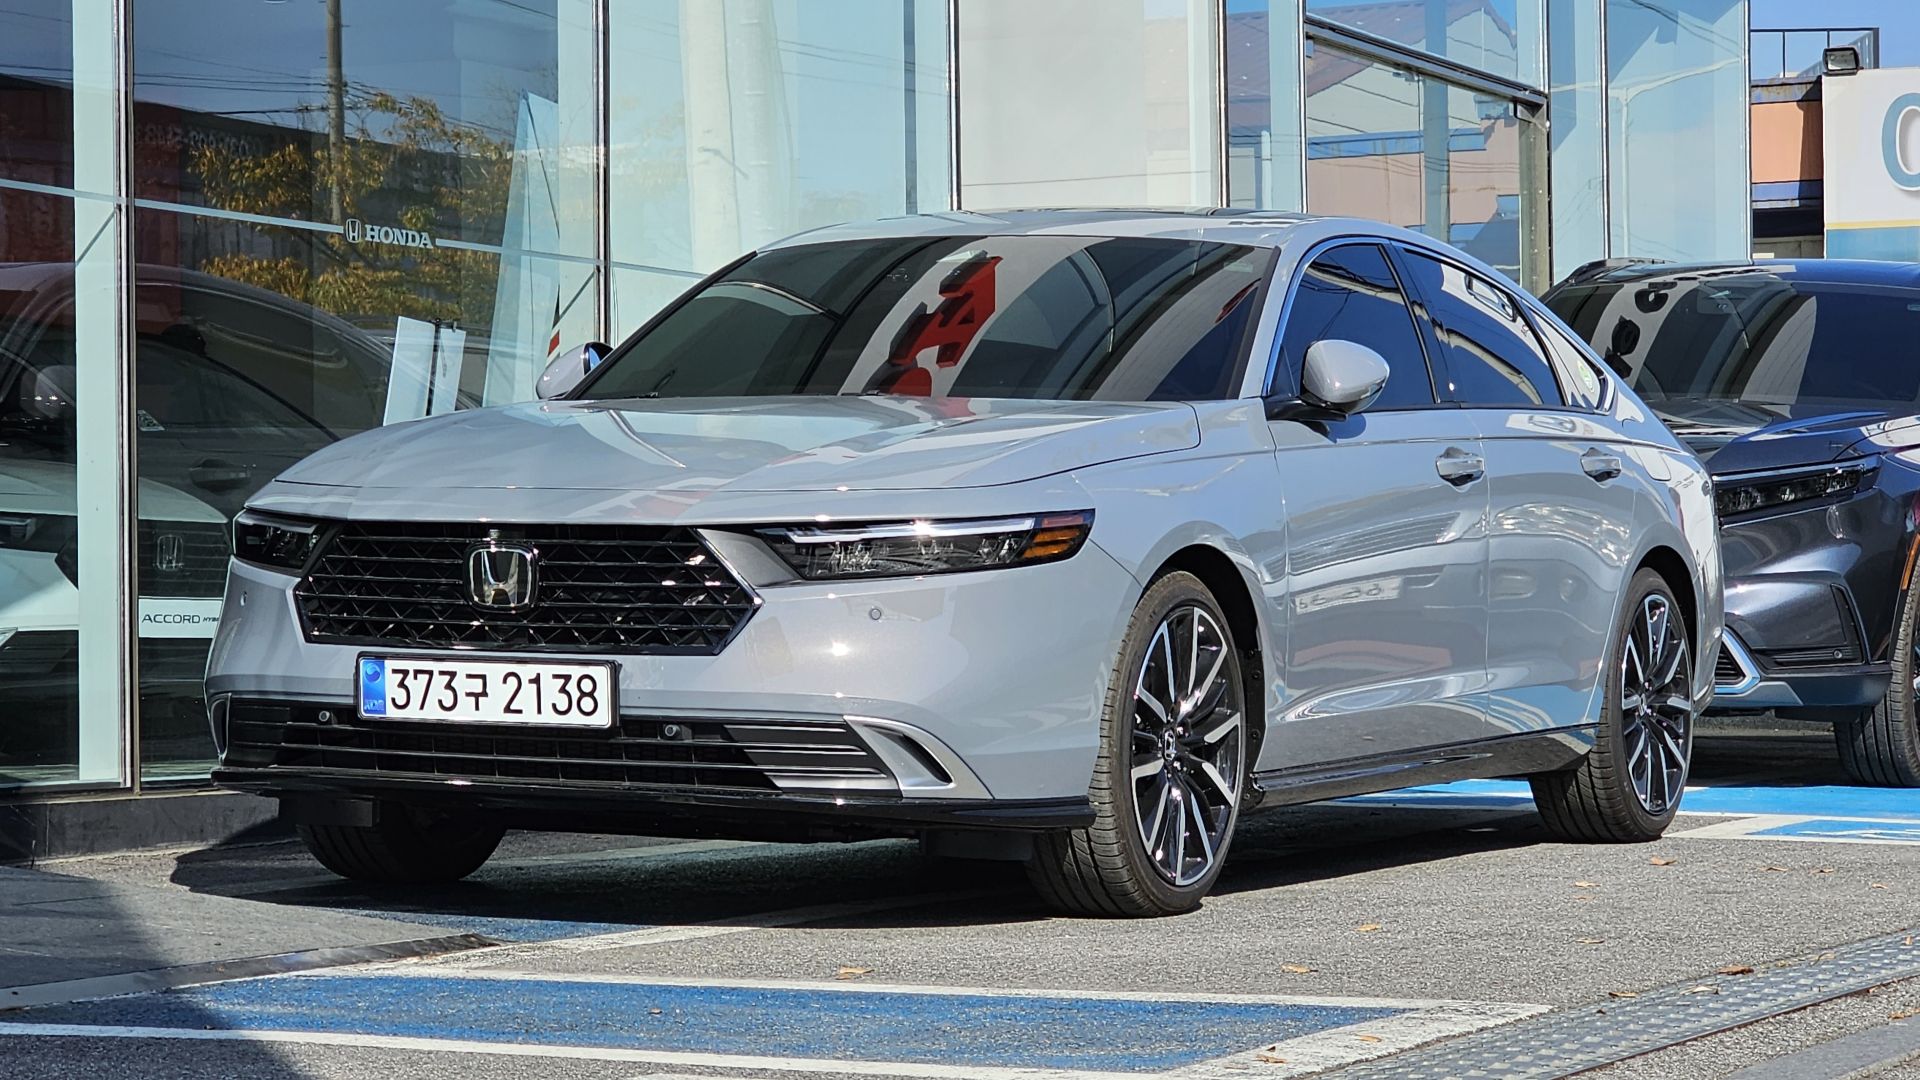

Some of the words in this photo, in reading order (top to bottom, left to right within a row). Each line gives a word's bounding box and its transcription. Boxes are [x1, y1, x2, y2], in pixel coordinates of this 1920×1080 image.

[365, 224, 433, 249] HONDA
[142, 614, 200, 624] ACCORD
[391, 668, 489, 712] 373구
[502, 671, 598, 717] 2138
